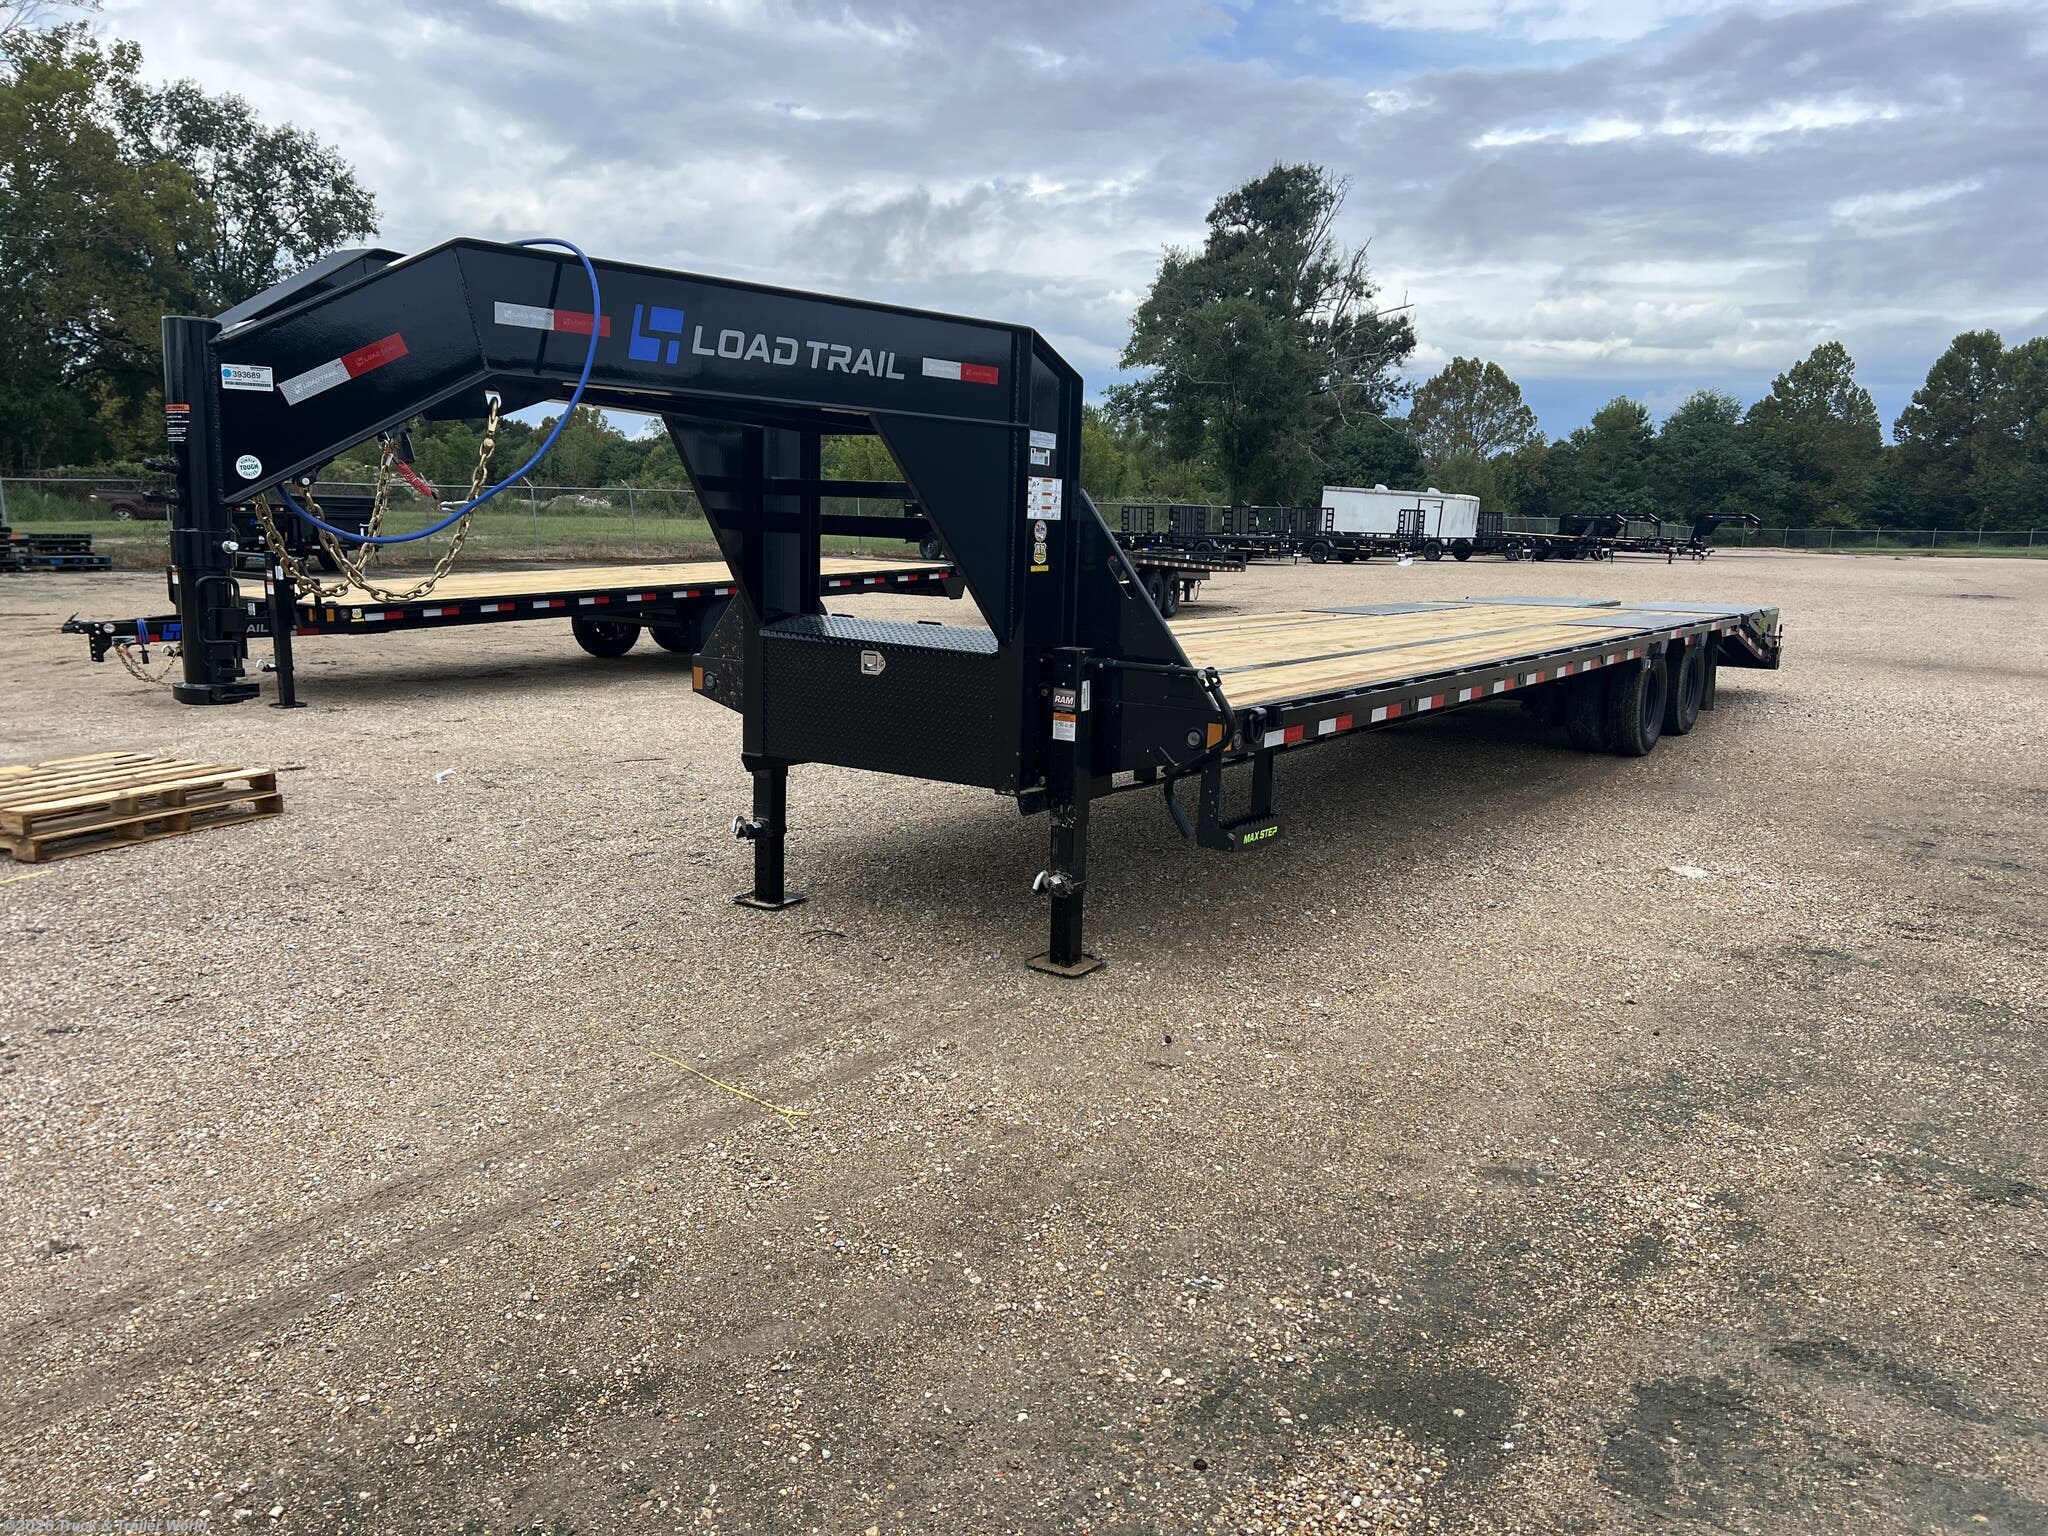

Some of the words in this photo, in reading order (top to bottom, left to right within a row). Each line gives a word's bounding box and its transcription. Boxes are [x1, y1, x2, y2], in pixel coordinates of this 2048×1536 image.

[692, 325, 799, 366] LOAD
[806, 340, 905, 380] TRAIL
[232, 370, 261, 379] 393689
[239, 463, 259, 471] TOUGH
[246, 623, 270, 633] AIL
[1054, 695, 1074, 705] RAM
[1243, 831, 1260, 845] MAX
[1259, 826, 1278, 839] STEP
